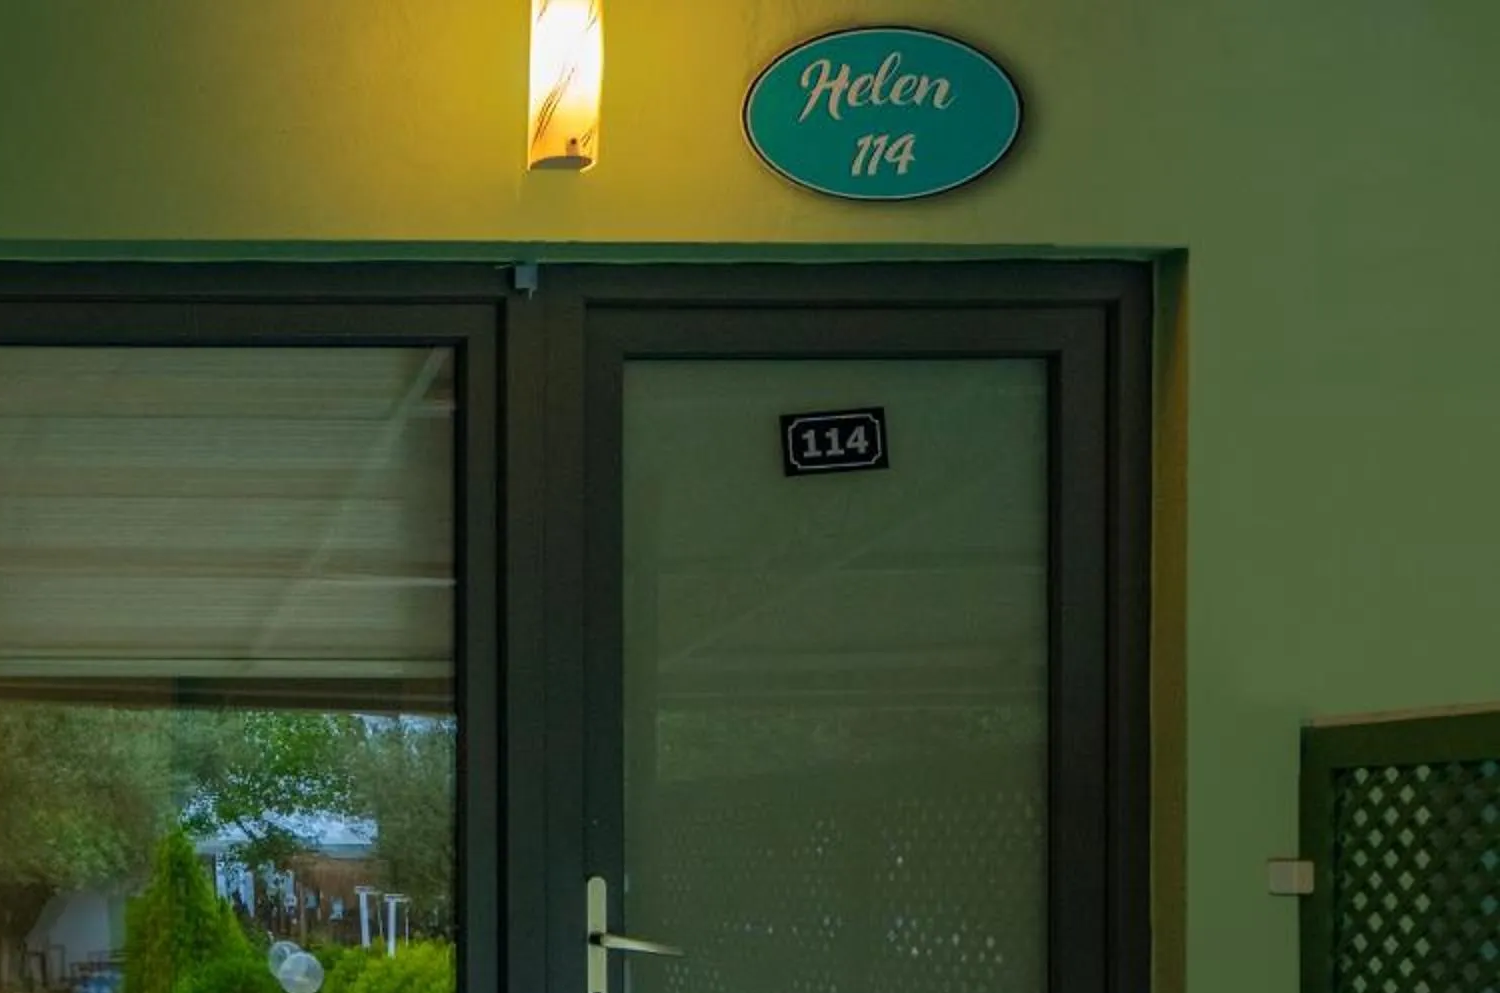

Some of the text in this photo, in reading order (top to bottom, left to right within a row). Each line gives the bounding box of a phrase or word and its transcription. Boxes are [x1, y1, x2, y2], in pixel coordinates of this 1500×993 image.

[799, 51, 957, 122] Helen
[852, 132, 916, 176] 114
[801, 425, 869, 458] 114
